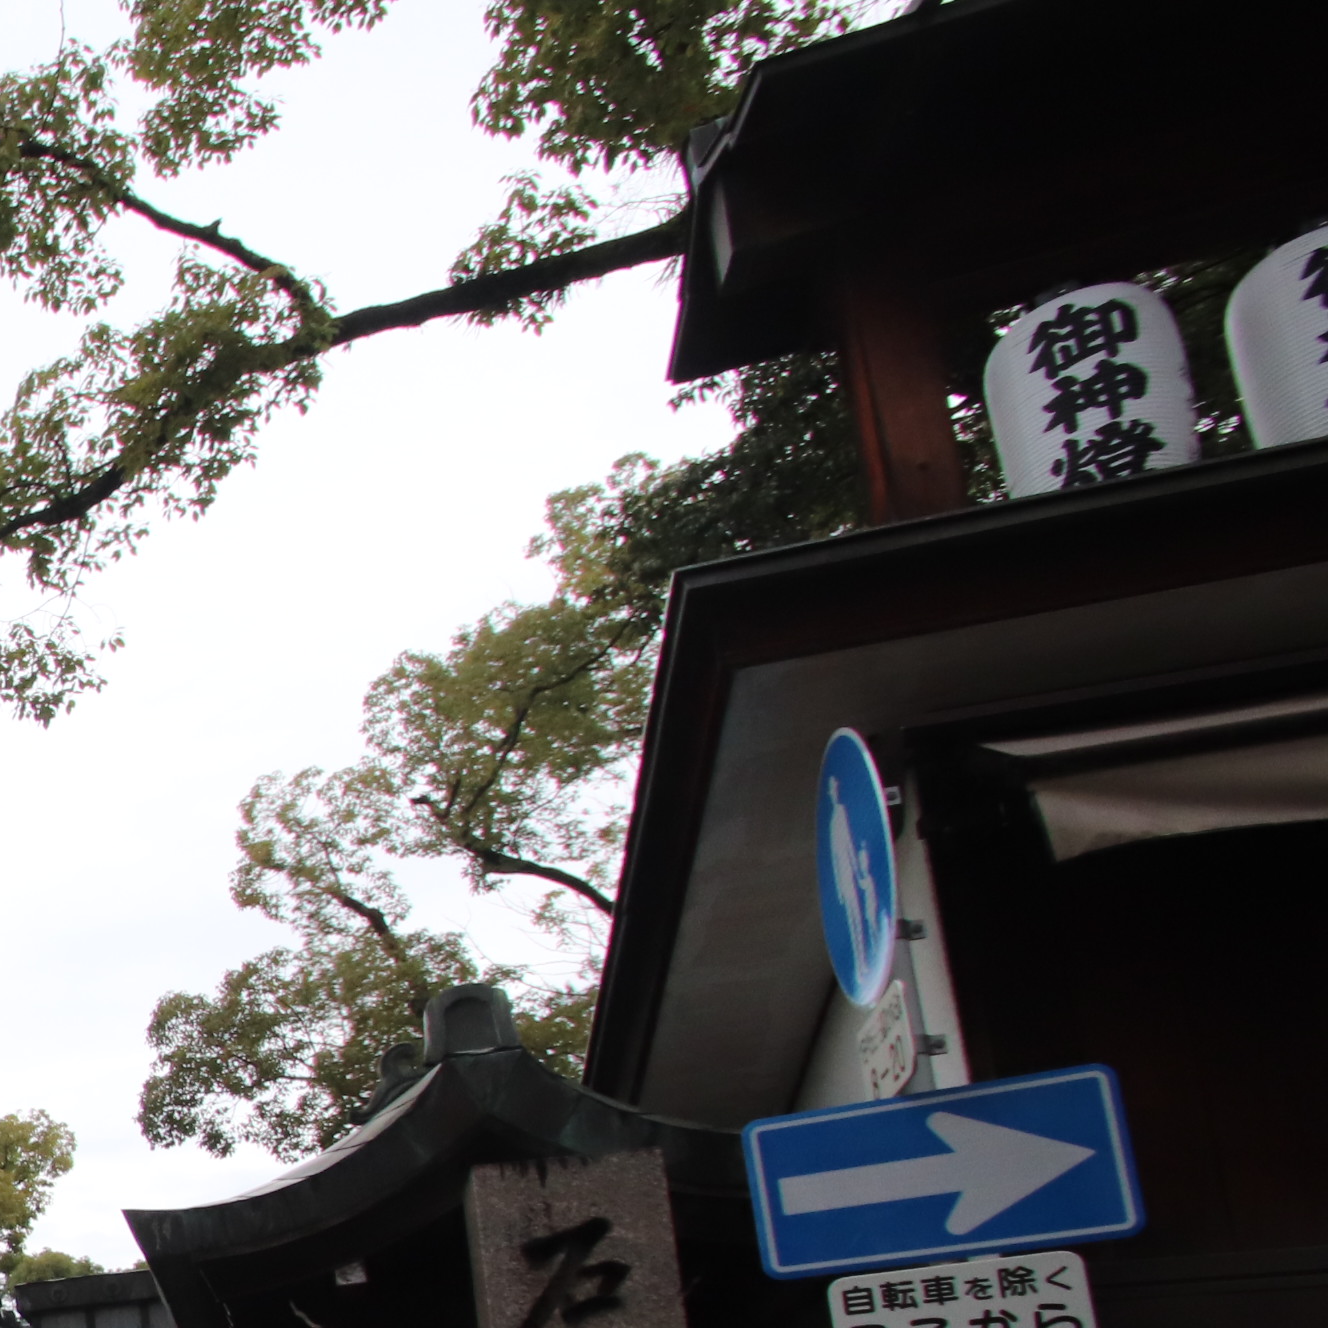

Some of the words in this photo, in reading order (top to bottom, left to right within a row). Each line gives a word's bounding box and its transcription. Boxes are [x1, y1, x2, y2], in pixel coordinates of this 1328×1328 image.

[842, 1266, 1075, 1316] 自転車を除く
